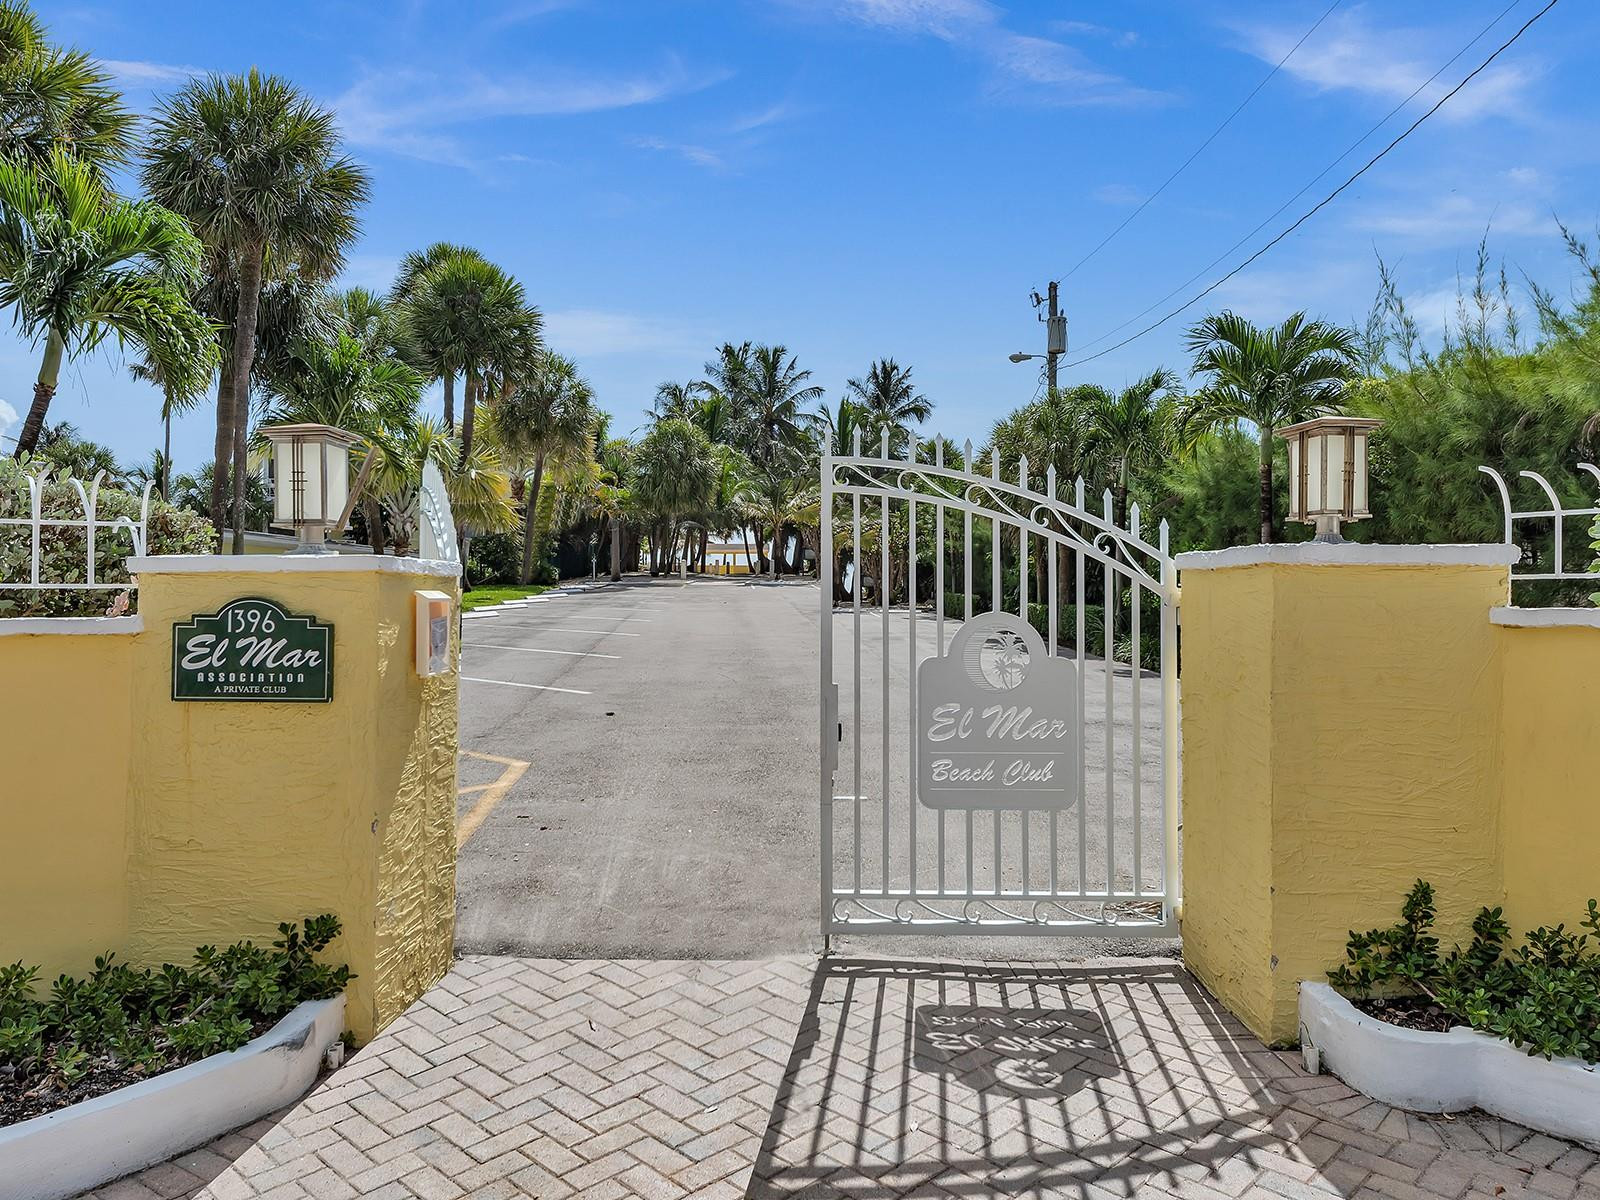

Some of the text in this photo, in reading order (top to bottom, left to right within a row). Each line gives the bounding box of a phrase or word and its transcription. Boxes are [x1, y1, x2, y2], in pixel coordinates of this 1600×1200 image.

[227, 609, 276, 633] 1396
[181, 633, 322, 670] El Mar
[197, 672, 305, 683] ASSOCIATION
[214, 685, 287, 693] A PRIVATE CLUB
[927, 703, 1068, 742] El Mar
[931, 759, 1055, 786] Beach Club
